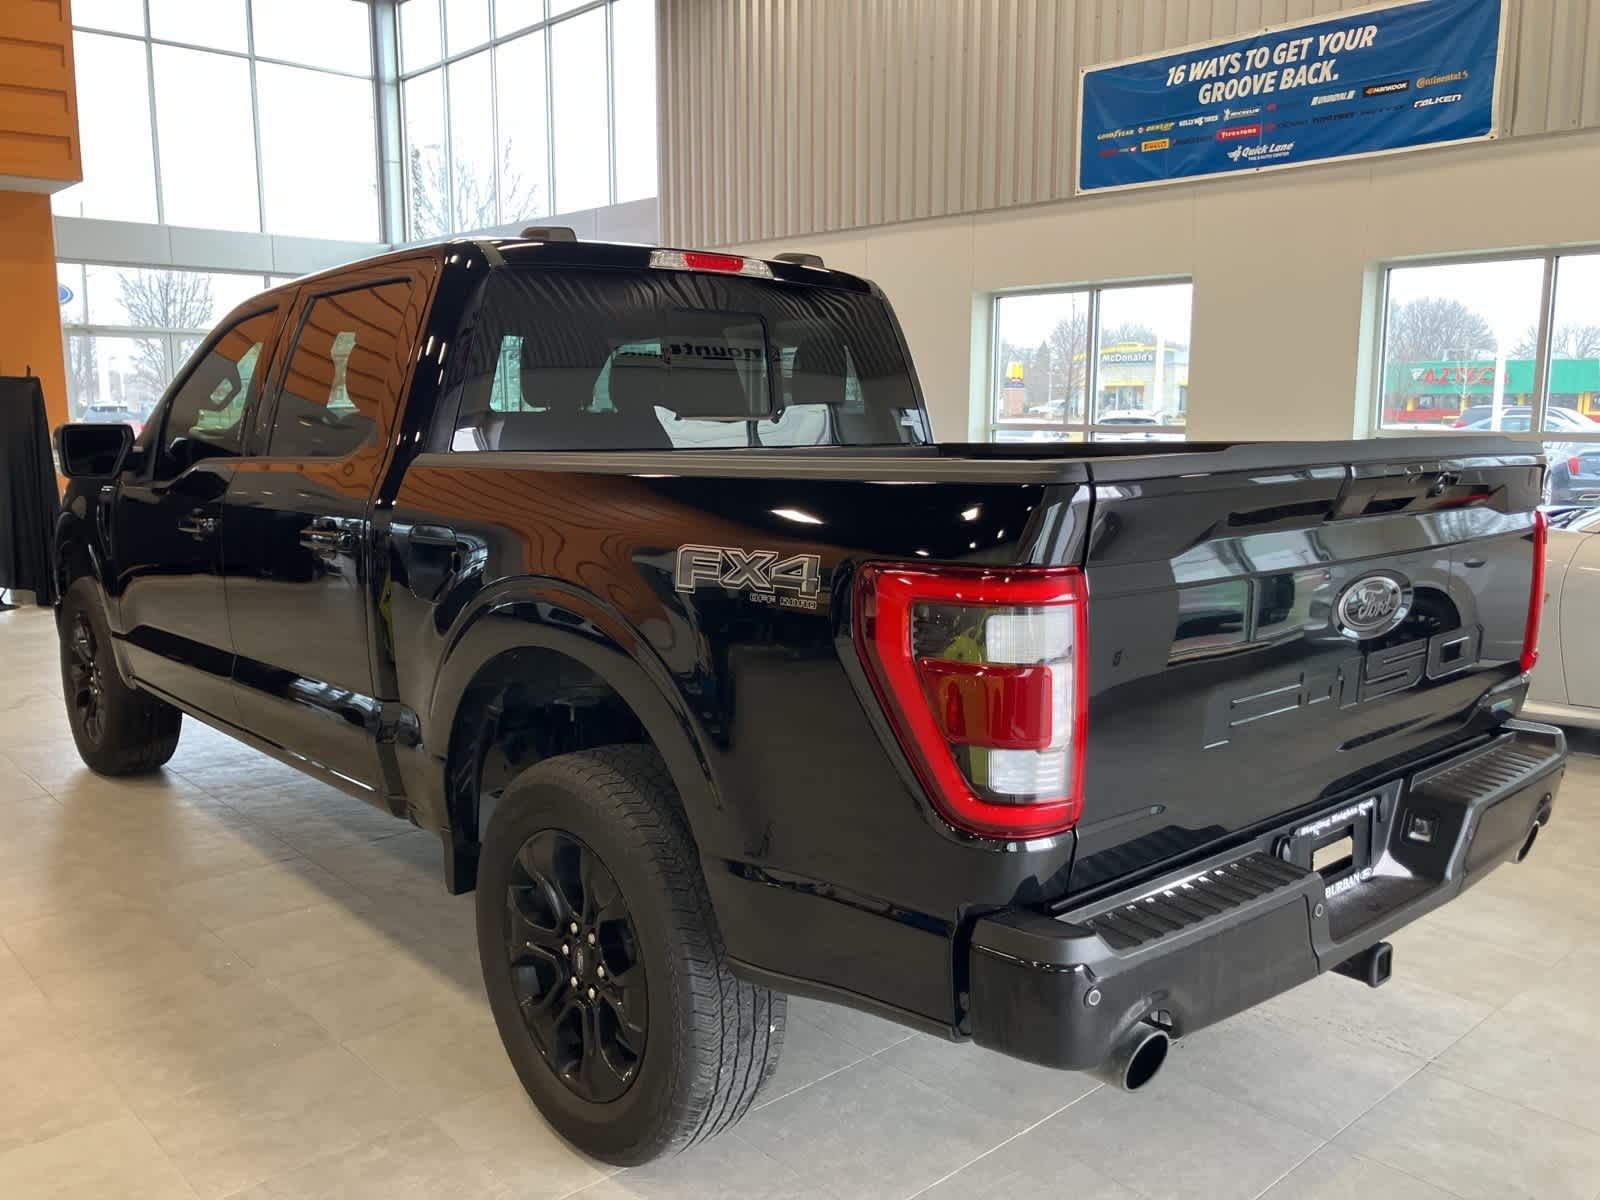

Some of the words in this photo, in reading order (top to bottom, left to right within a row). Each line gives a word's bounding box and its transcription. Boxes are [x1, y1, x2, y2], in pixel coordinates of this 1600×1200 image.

[1166, 65, 1186, 87] 16
[1188, 52, 1242, 82] WAYS
[1244, 46, 1270, 72] TO
[1273, 37, 1314, 65] GET
[1317, 25, 1378, 57] YOUR
[1198, 70, 1279, 105] GROOVE
[1279, 59, 1339, 90] BACK.
[1414, 94, 1462, 108] FALKEN
[1241, 144, 1269, 158] Quick
[1268, 142, 1294, 153] Lane
[1102, 351, 1153, 363] McDonald's
[675, 544, 821, 599] FX4
[1357, 588, 1396, 620] Ford
